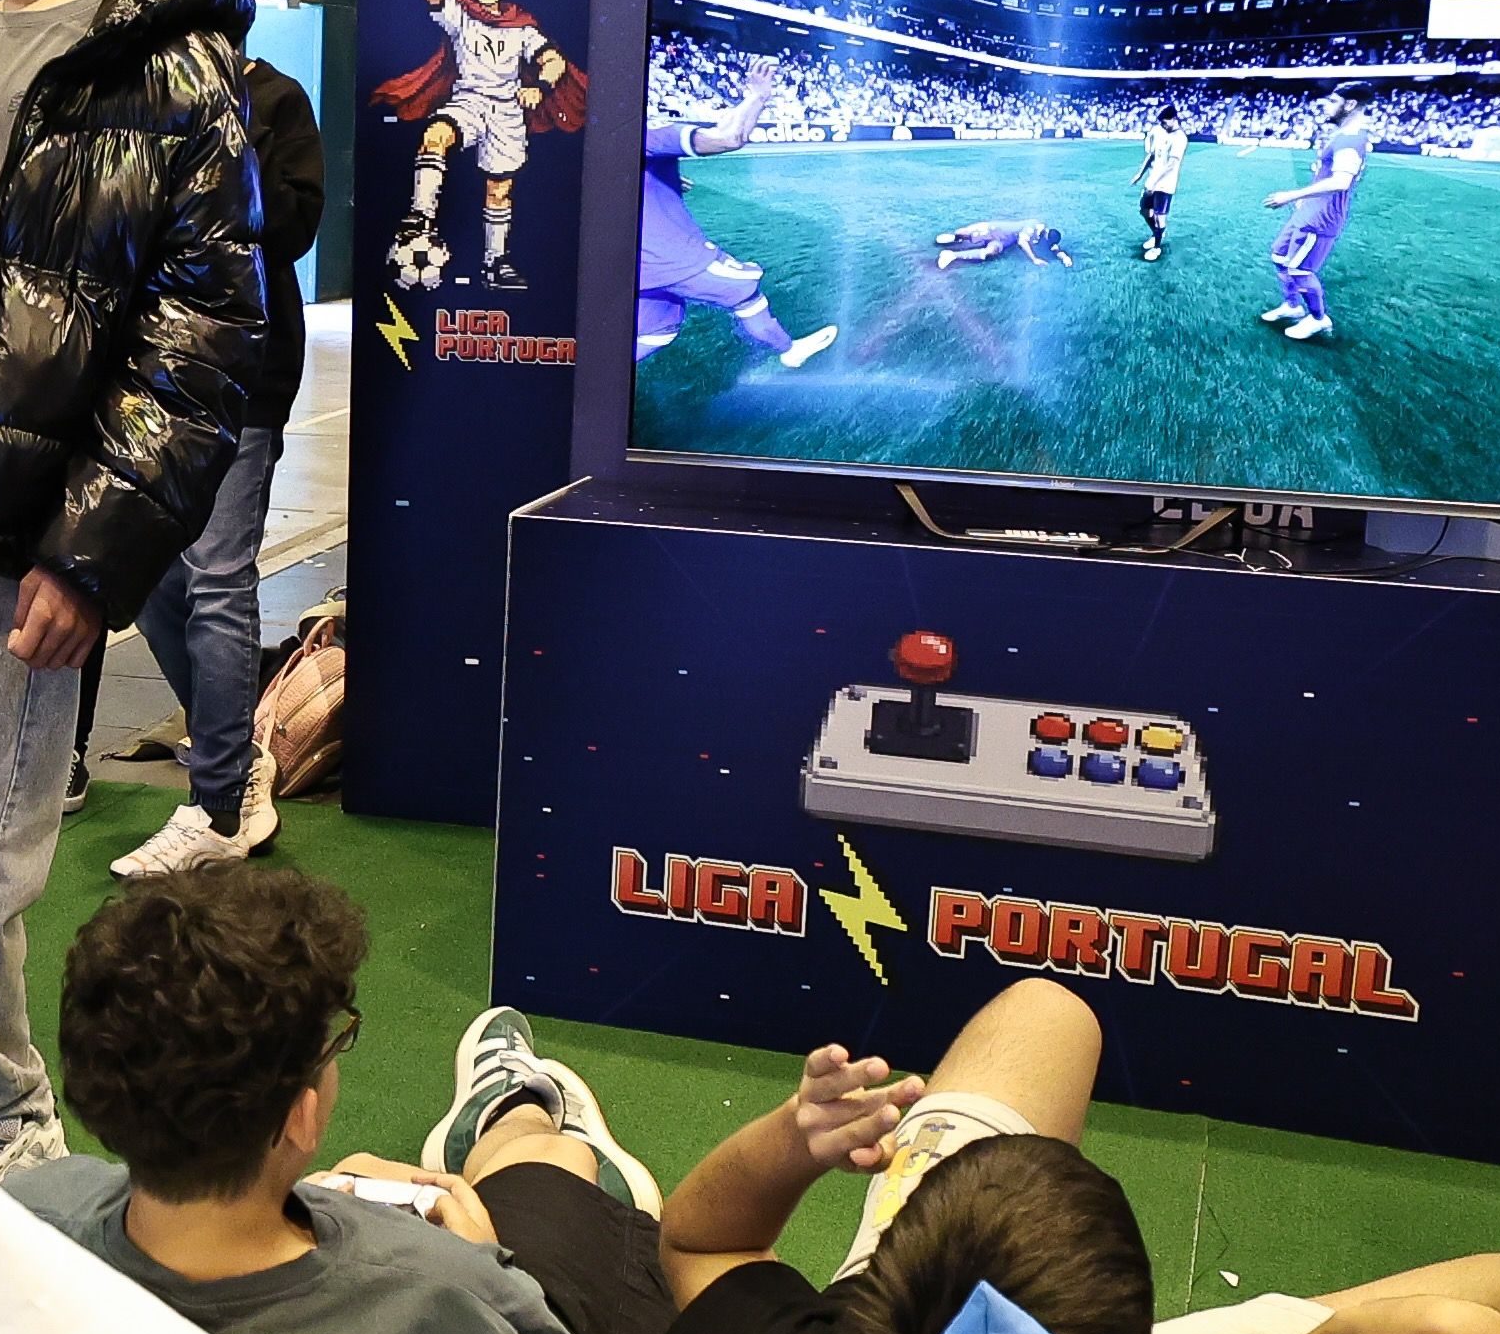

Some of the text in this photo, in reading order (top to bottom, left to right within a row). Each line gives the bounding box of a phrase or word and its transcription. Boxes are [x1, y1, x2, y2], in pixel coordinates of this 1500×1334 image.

[436, 309, 509, 336] LIGA
[611, 845, 1420, 1023] LIGA PORTUGAL
